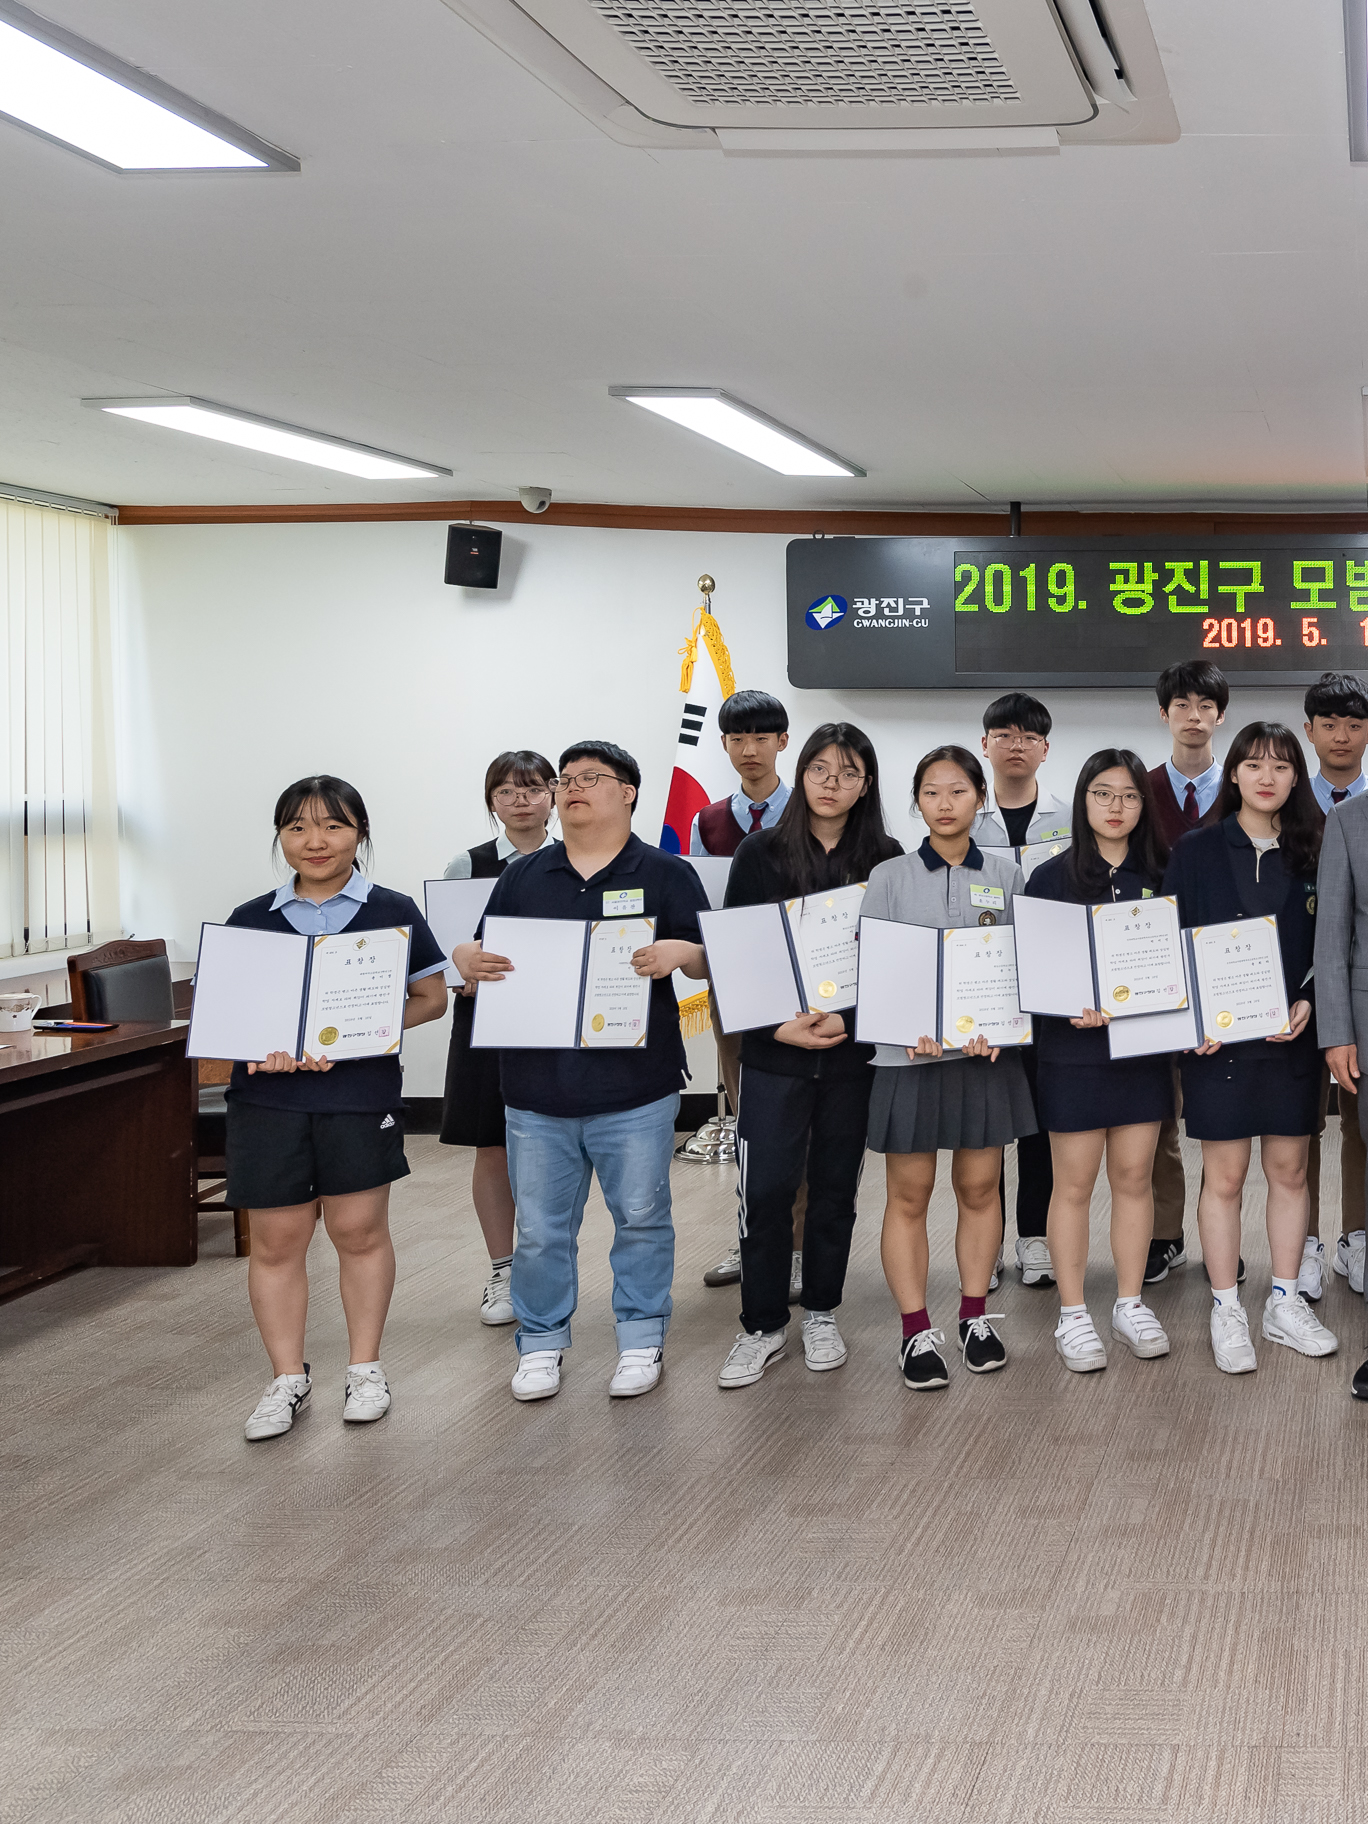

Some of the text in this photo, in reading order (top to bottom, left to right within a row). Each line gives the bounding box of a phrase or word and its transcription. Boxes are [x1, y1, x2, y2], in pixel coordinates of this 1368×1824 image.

[954, 562, 1087, 613] 2019.
[1109, 560, 1265, 615] 광진구
[852, 596, 931, 616] 광진구
[853, 618, 929, 629] GWANGJIN-GU
[1202, 617, 1282, 648] 2019.
[1302, 617, 1327, 647] 5.
